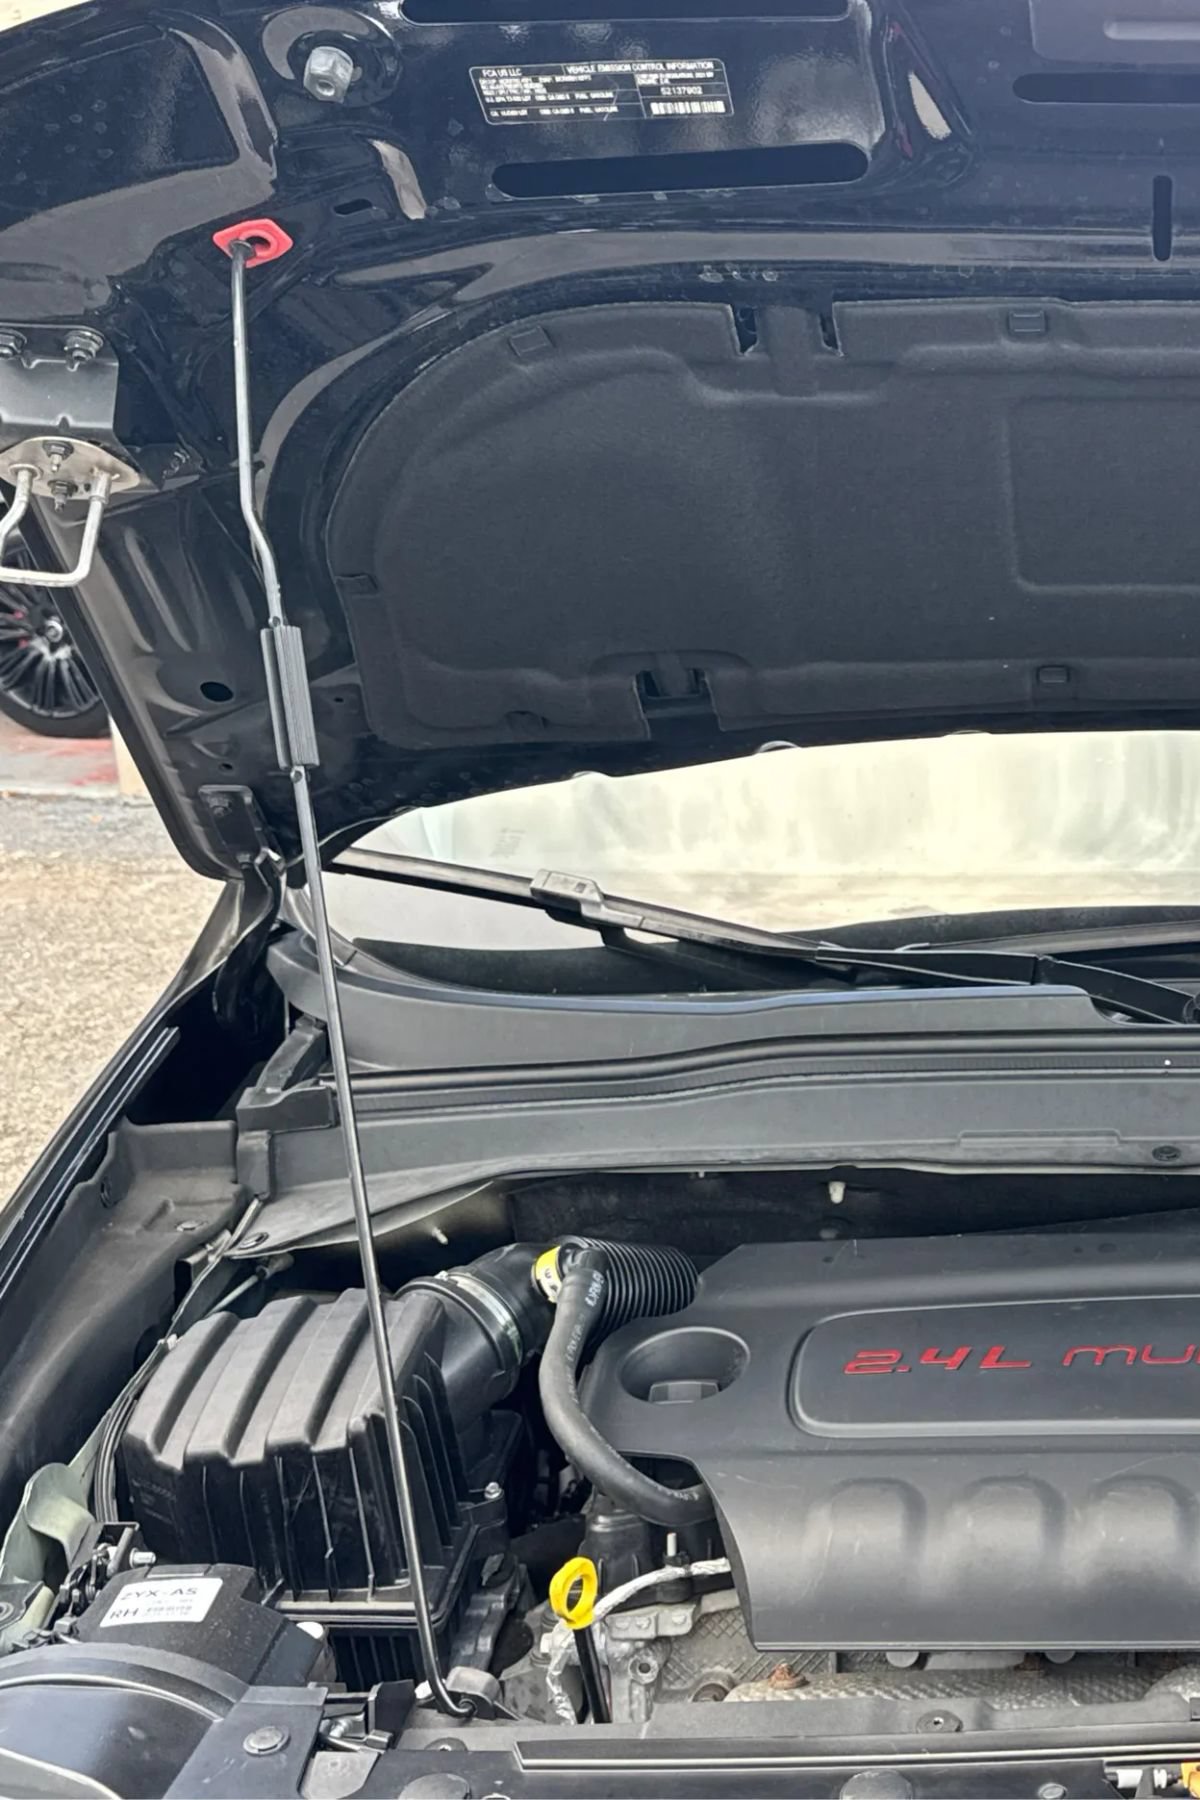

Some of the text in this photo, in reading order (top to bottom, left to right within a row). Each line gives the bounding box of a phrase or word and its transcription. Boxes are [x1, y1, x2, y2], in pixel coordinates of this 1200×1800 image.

[482, 69, 498, 78] FCA
[509, 67, 523, 76] LLC
[566, 61, 714, 74] VEHICLE EMISSION CONTROL INFORMATION
[109, 1607, 139, 1619] RH
